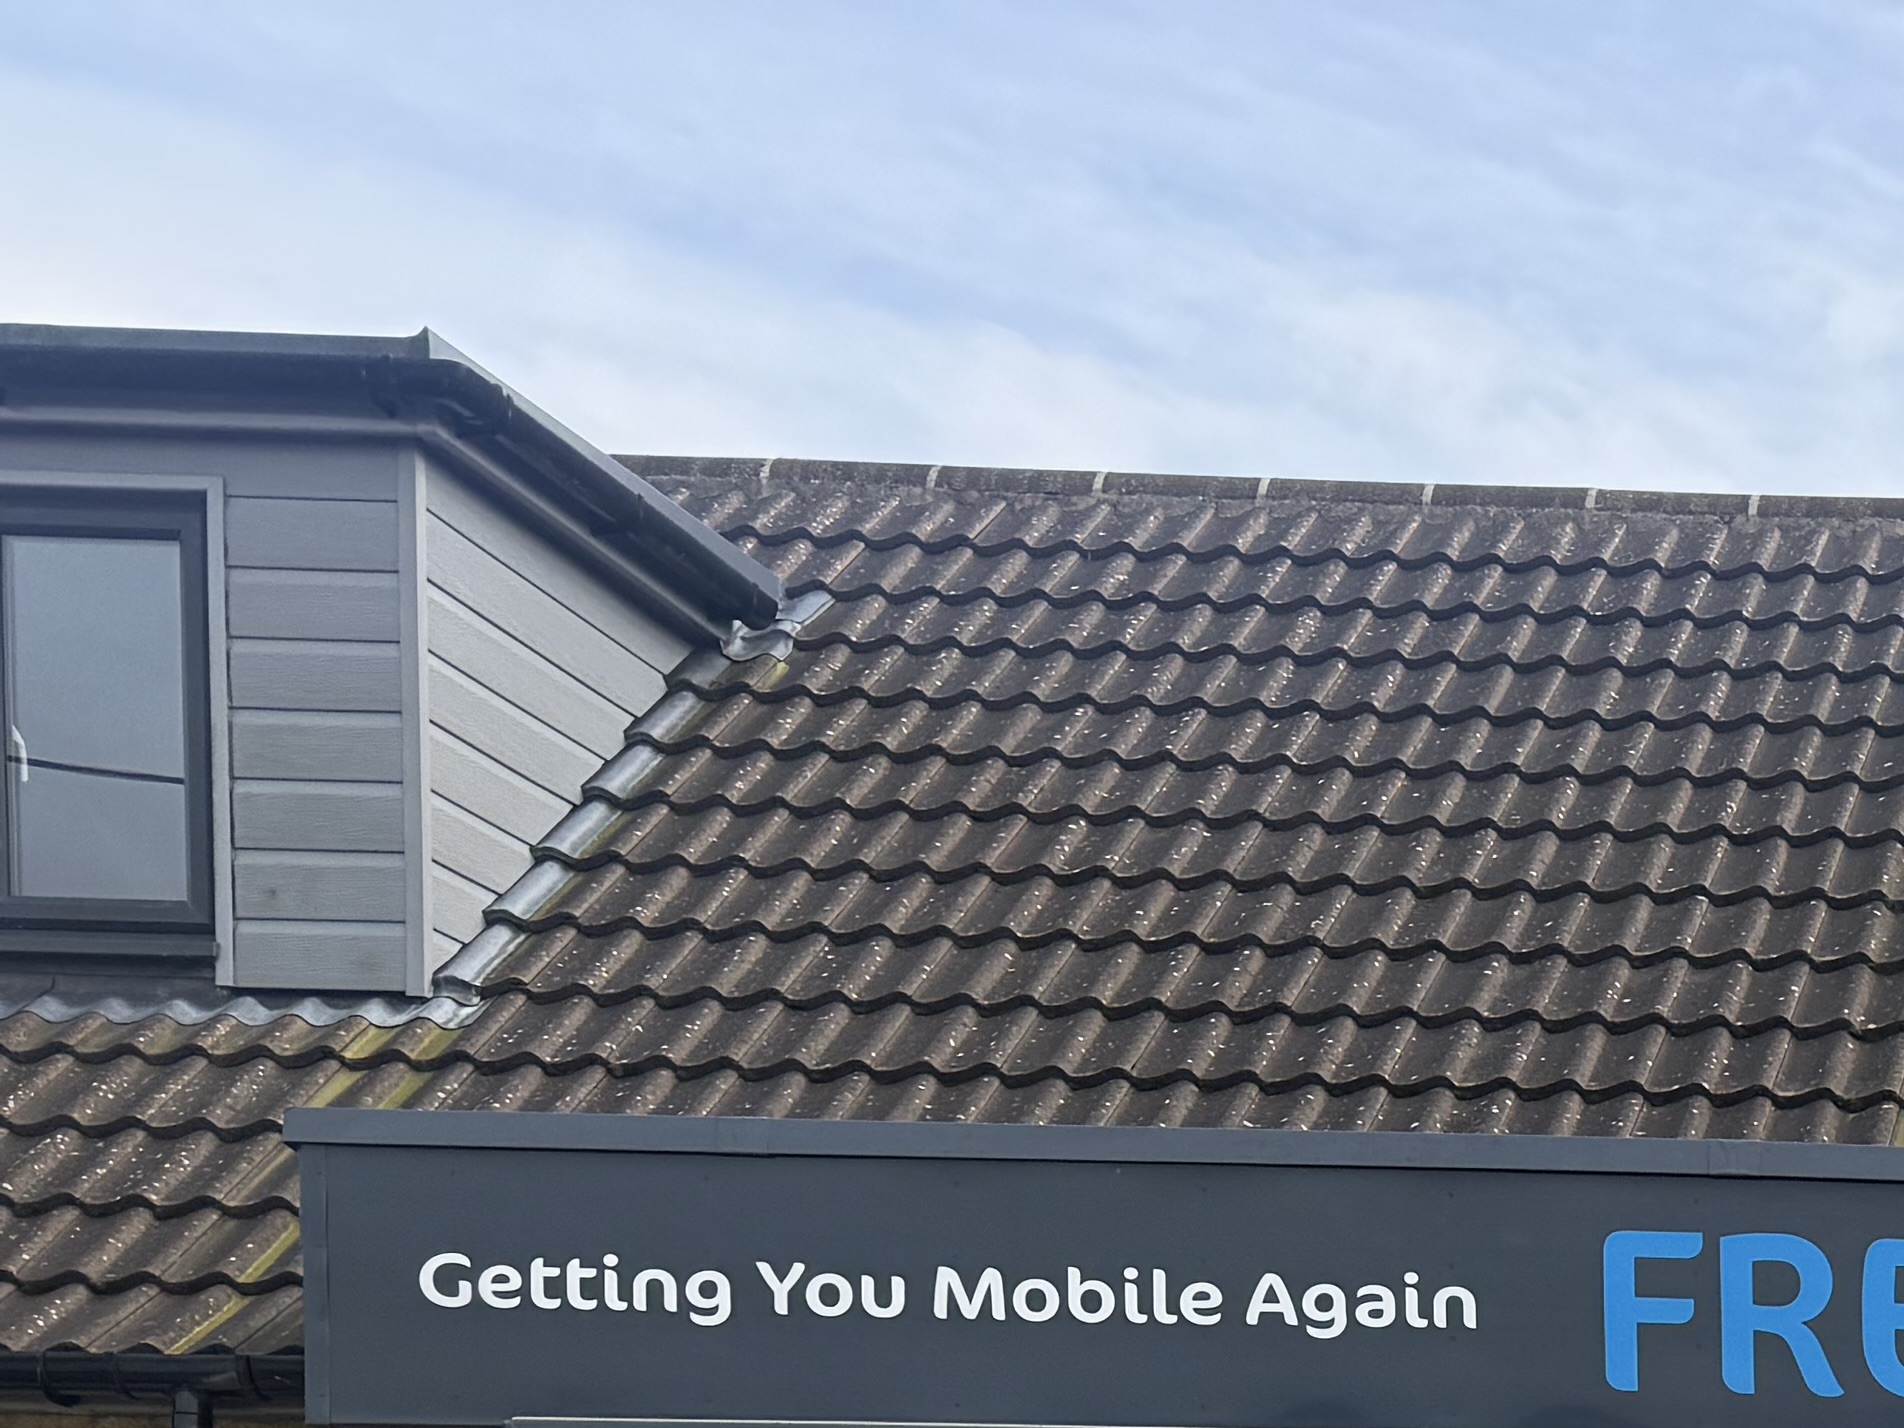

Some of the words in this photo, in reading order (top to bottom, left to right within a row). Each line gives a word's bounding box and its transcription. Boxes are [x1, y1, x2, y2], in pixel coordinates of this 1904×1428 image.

[418, 1252, 732, 1326] Getting
[755, 1261, 906, 1318] You
[933, 1266, 1223, 1326] Mobile
[1245, 1271, 1477, 1339] Again
